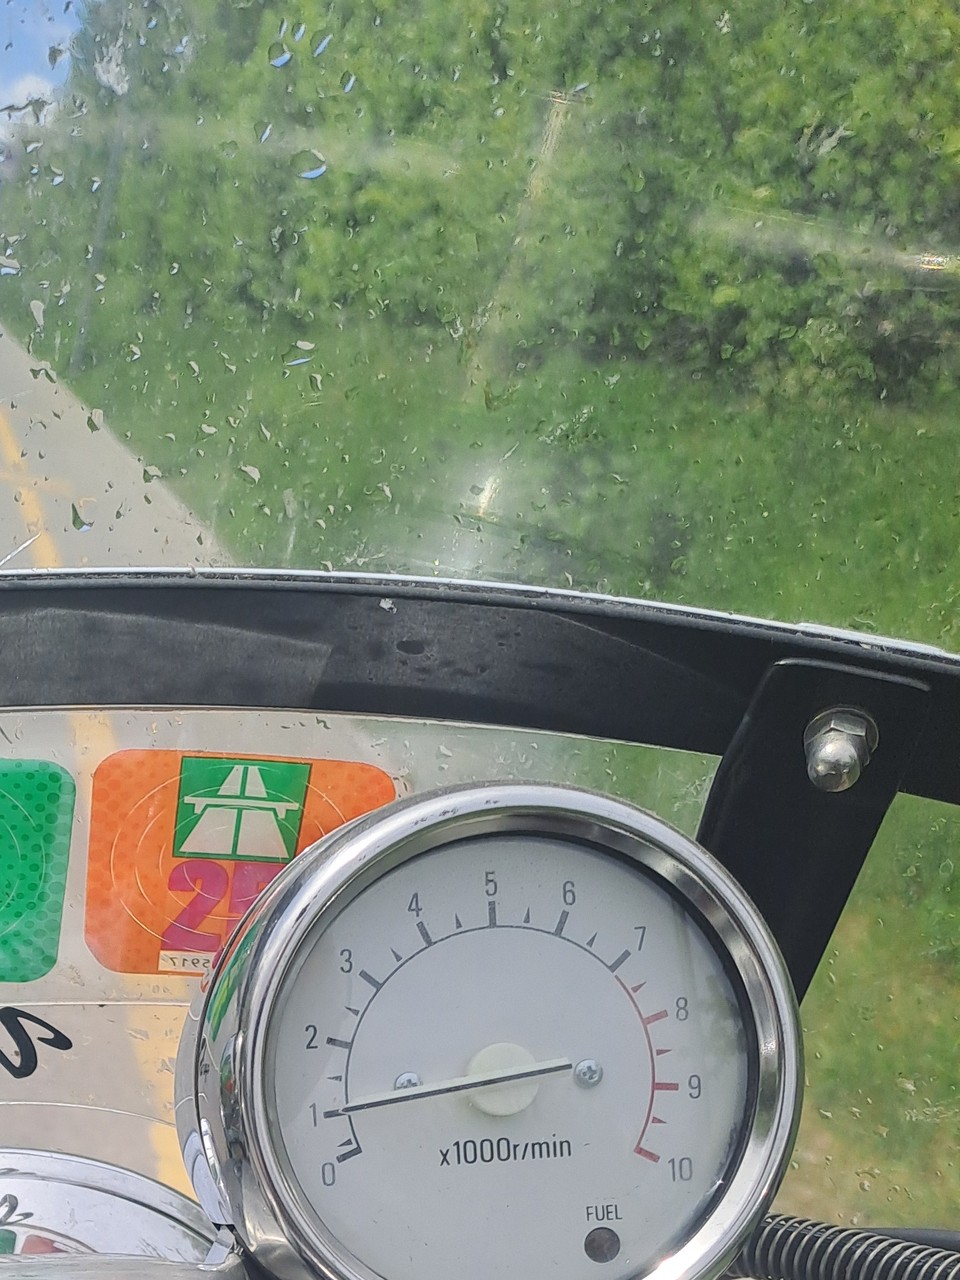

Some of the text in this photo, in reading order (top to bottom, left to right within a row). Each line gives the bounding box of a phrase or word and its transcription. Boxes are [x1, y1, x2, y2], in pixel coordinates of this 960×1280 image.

[484, 870, 498, 897] 5
[562, 880, 576, 906] 6
[407, 892, 423, 918] 4
[633, 925, 647, 952] 7
[339, 948, 353, 974] 3
[675, 996, 689, 1022] 8
[304, 1024, 319, 1050] 2
[688, 1074, 702, 1100] 9
[309, 1102, 318, 1128] 1
[439, 1133, 572, 1167] x1000r/min
[321, 1162, 336, 1187] 0
[668, 1157, 694, 1182] 10
[585, 1204, 623, 1222] FUEL
